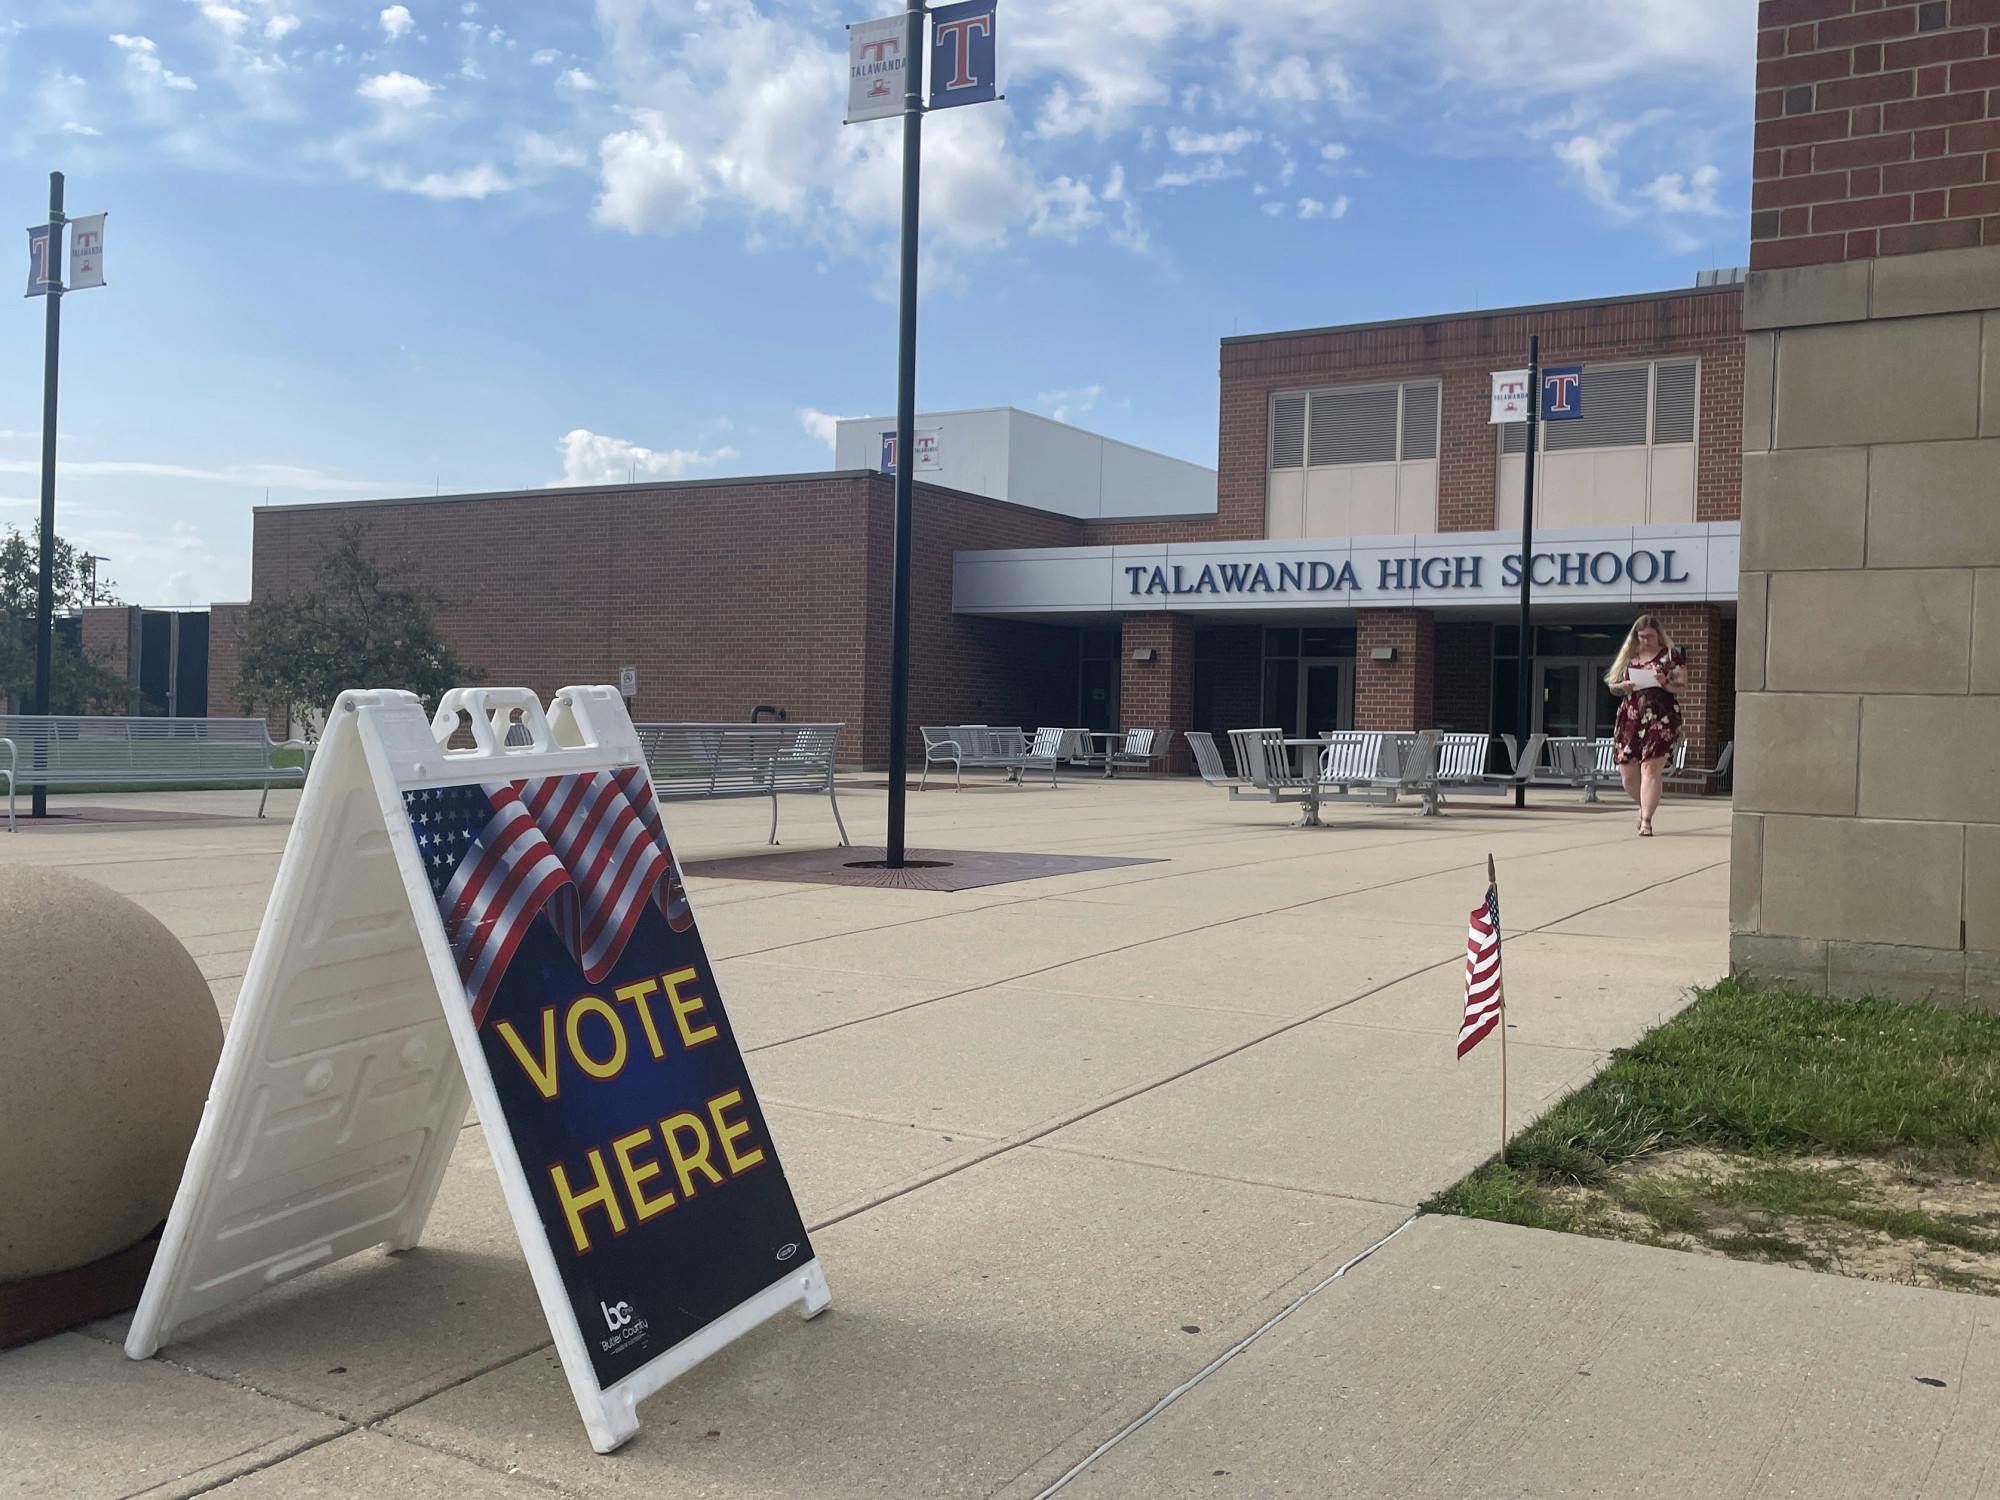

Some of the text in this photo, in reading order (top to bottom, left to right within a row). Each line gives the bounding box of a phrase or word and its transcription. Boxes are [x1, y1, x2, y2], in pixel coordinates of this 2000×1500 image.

[851, 57, 907, 78] TALAWANDA
[860, 37, 900, 61] T
[936, 14, 990, 91] T
[1545, 374, 1579, 411] T
[1125, 550, 1689, 595] TALAWANDA HIGH SCHOOL
[493, 967, 720, 1100] VOTE
[548, 1088, 766, 1254] HERE
